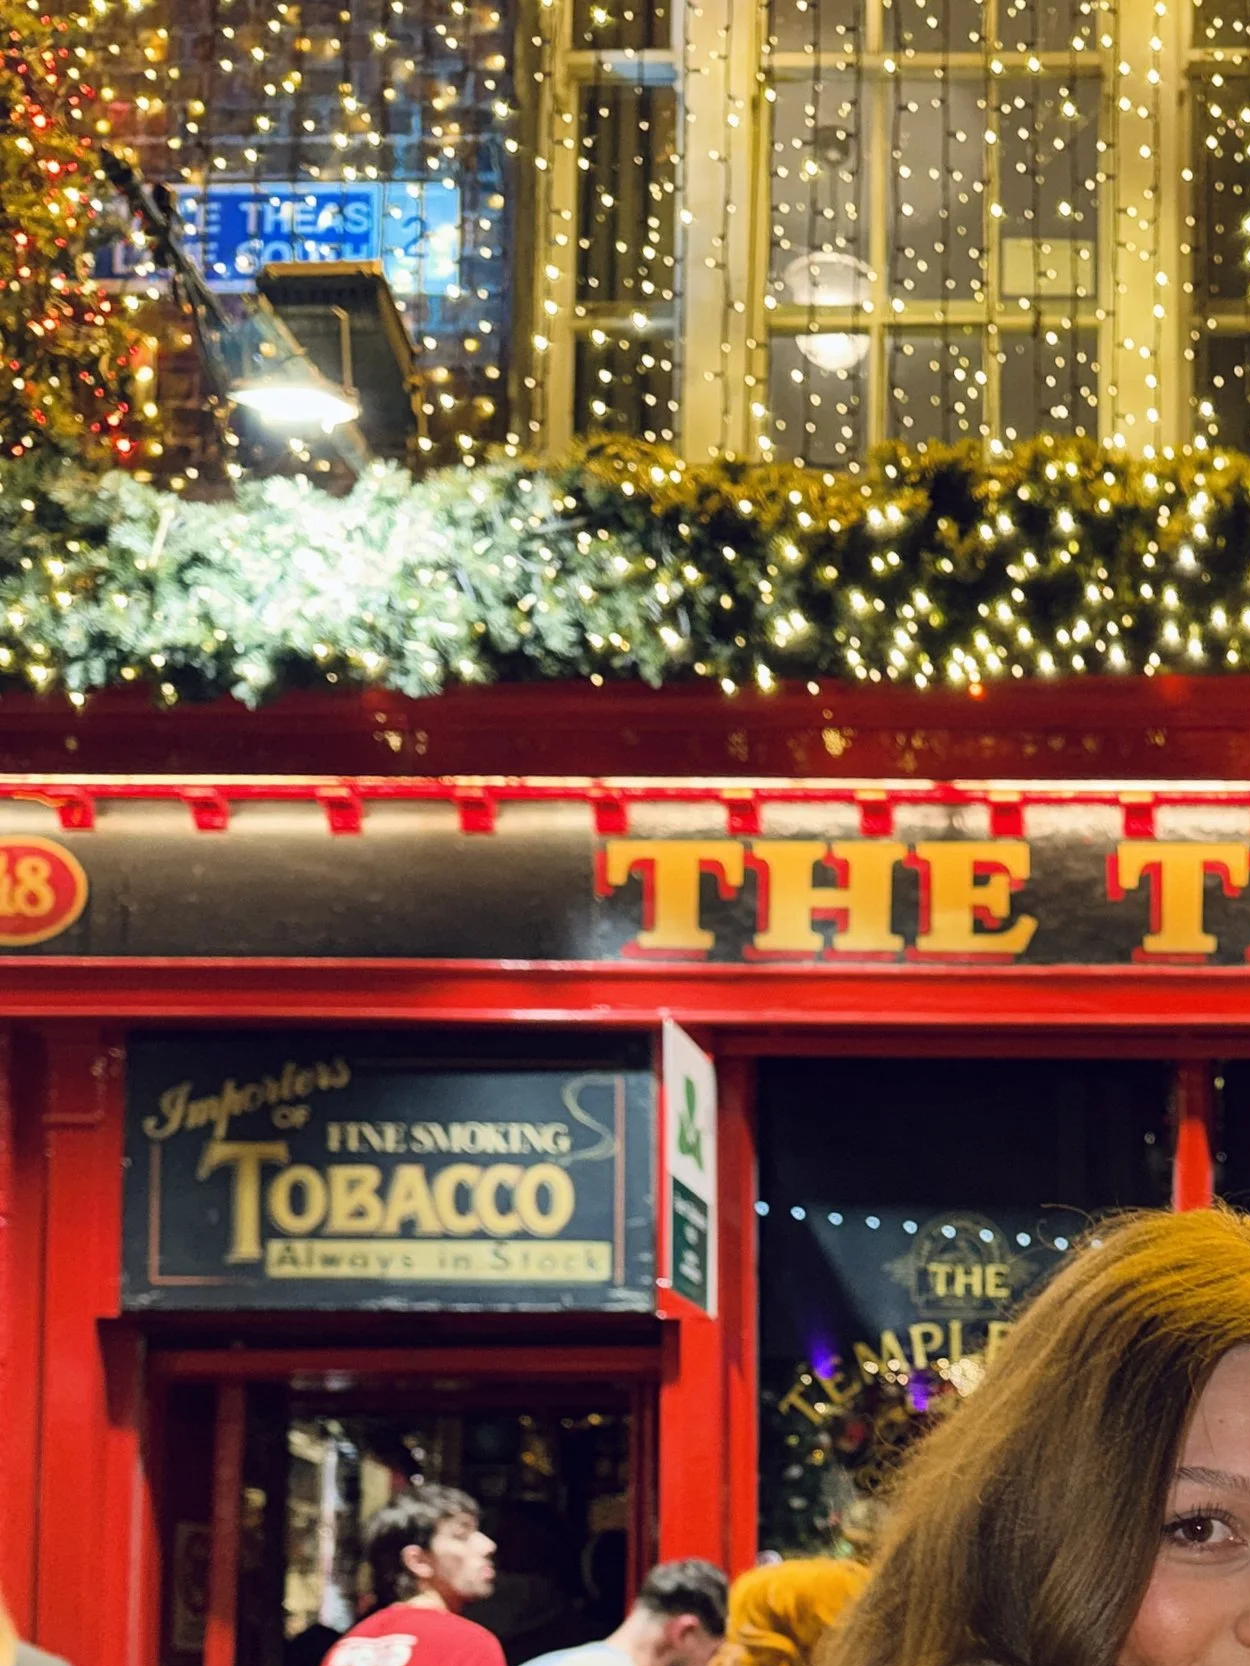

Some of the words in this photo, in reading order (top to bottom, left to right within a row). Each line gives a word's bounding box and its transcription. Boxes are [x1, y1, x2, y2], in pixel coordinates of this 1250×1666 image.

[594, 840, 1040, 964] THE
[141, 1054, 351, 1140] Importers
[326, 1121, 408, 1153] FINE
[411, 1120, 572, 1154] SMOKING
[198, 1141, 577, 1265] TOBACCO
[274, 1244, 414, 1278] Always
[438, 1243, 473, 1269] in
[490, 1242, 602, 1271] Stock
[926, 1261, 1010, 1298] THE
